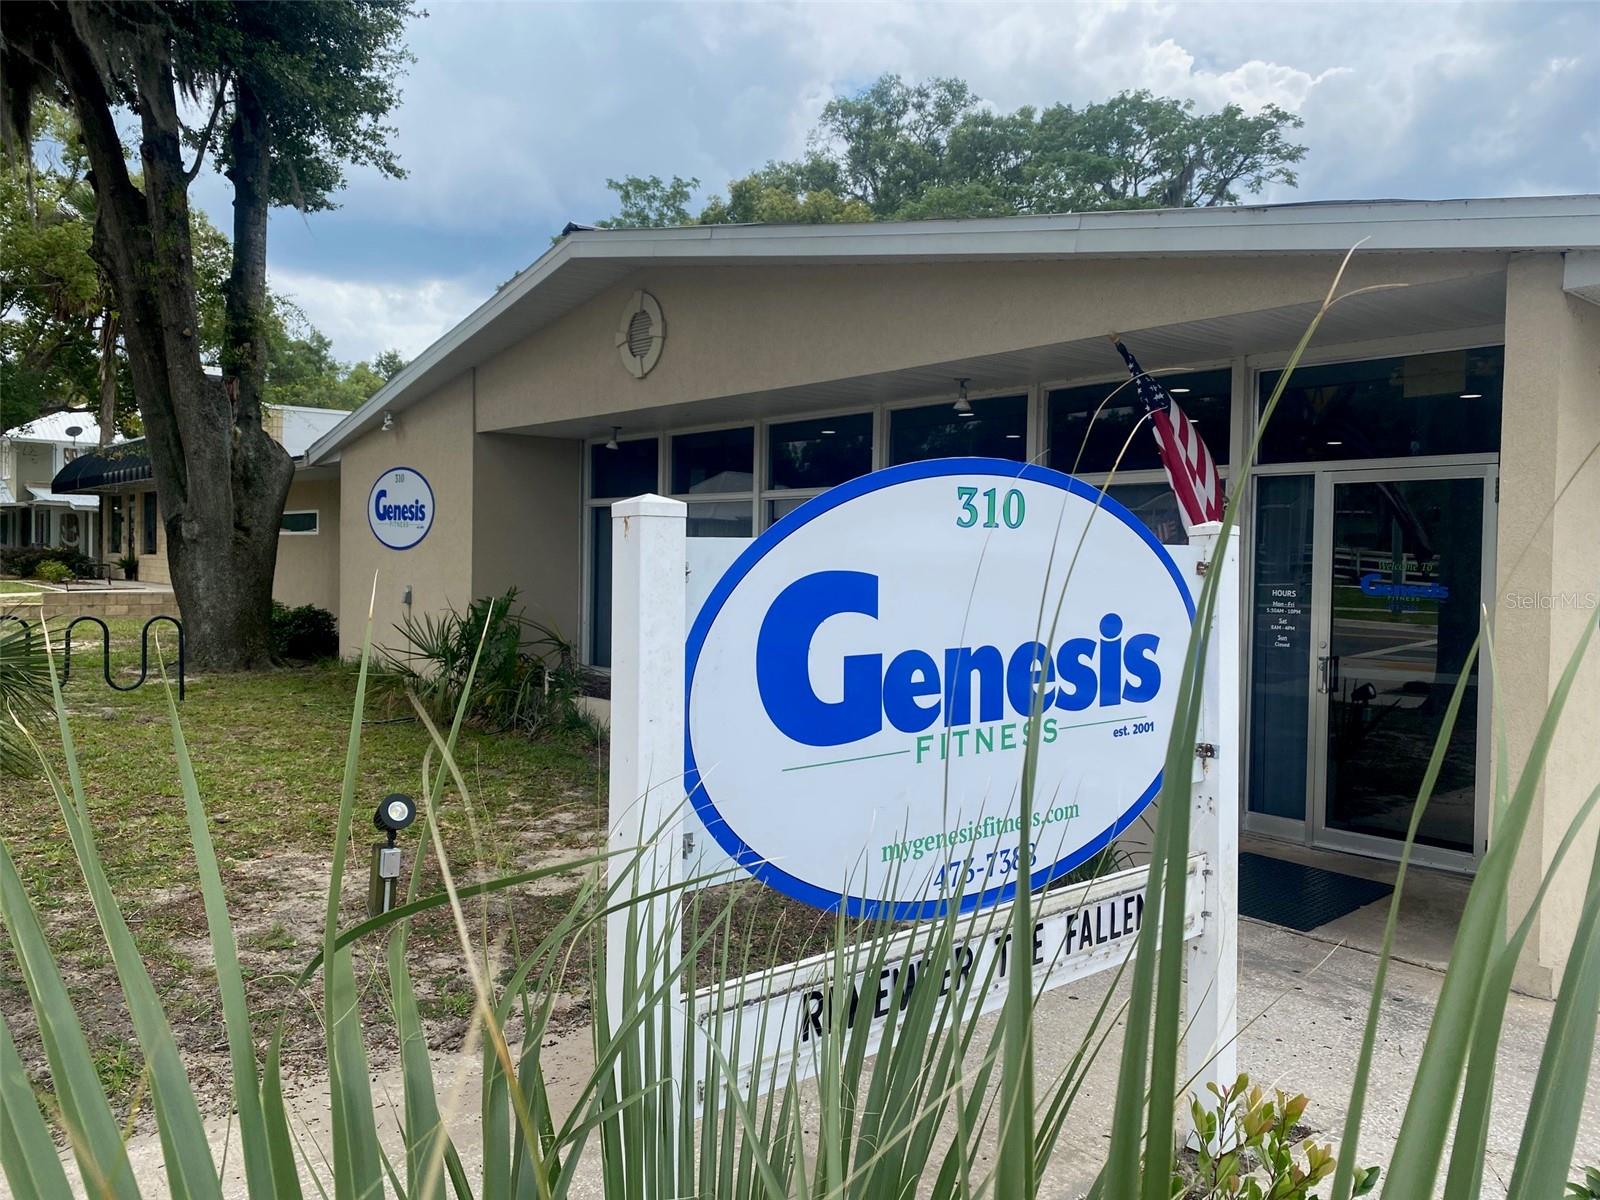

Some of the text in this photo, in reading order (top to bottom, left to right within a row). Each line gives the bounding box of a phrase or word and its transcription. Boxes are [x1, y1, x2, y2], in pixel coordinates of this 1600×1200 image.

[394, 474, 405, 483] 310
[375, 489, 426, 521] Genesis
[956, 486, 1026, 529] 310
[1378, 560, 1433, 571] Welcome To
[1272, 589, 1297, 597] HOURS
[756, 570, 1161, 748] Genesis
[1113, 721, 1154, 738] est. 2001
[881, 803, 1080, 863] mygenesisfitnes.com
[802, 946, 973, 1042] REER
[995, 923, 1044, 977] TE
